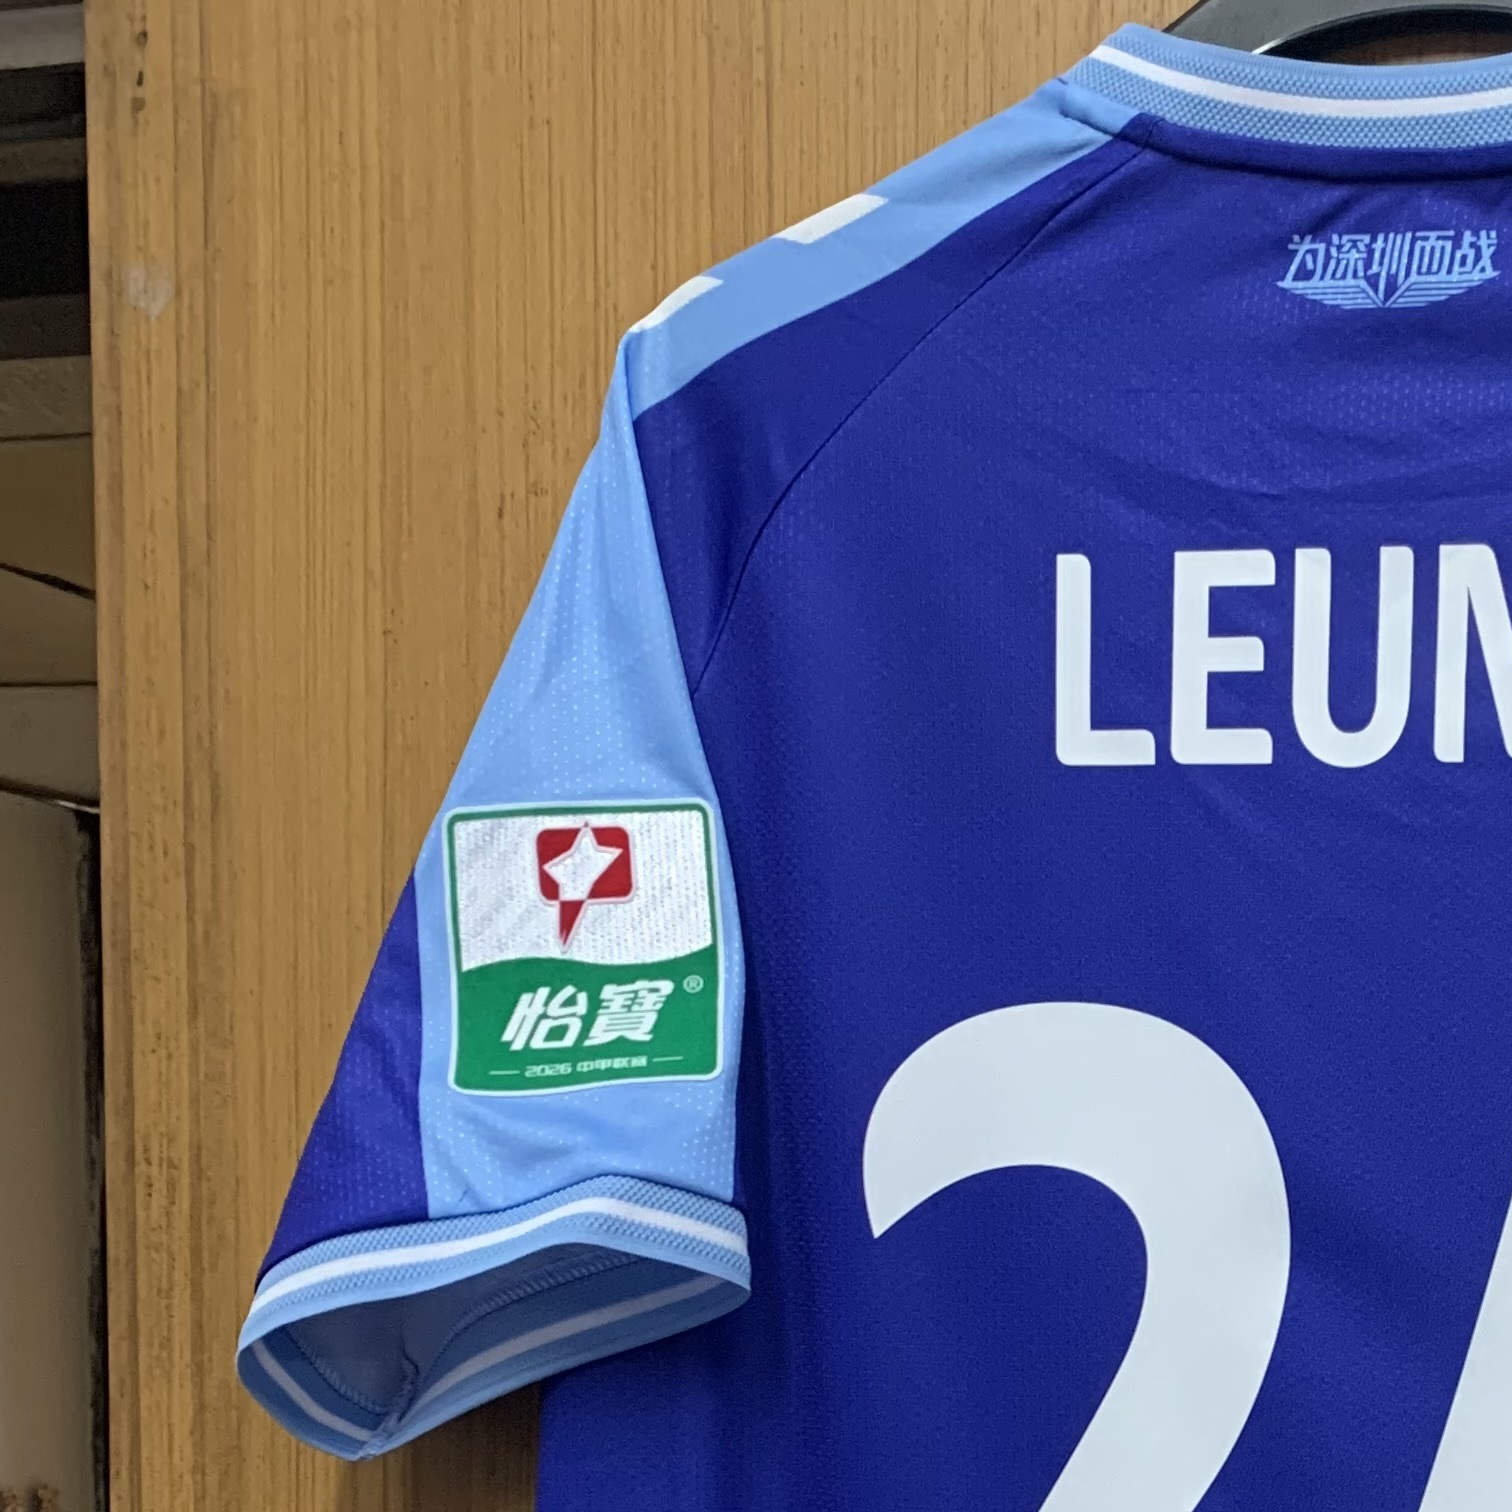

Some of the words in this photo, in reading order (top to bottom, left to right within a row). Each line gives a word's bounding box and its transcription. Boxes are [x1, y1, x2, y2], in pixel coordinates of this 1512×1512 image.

[1281, 229, 1500, 300] 为深圳而战
[500, 979, 675, 1052] 怡寶
[524, 1062, 573, 1078] 2026
